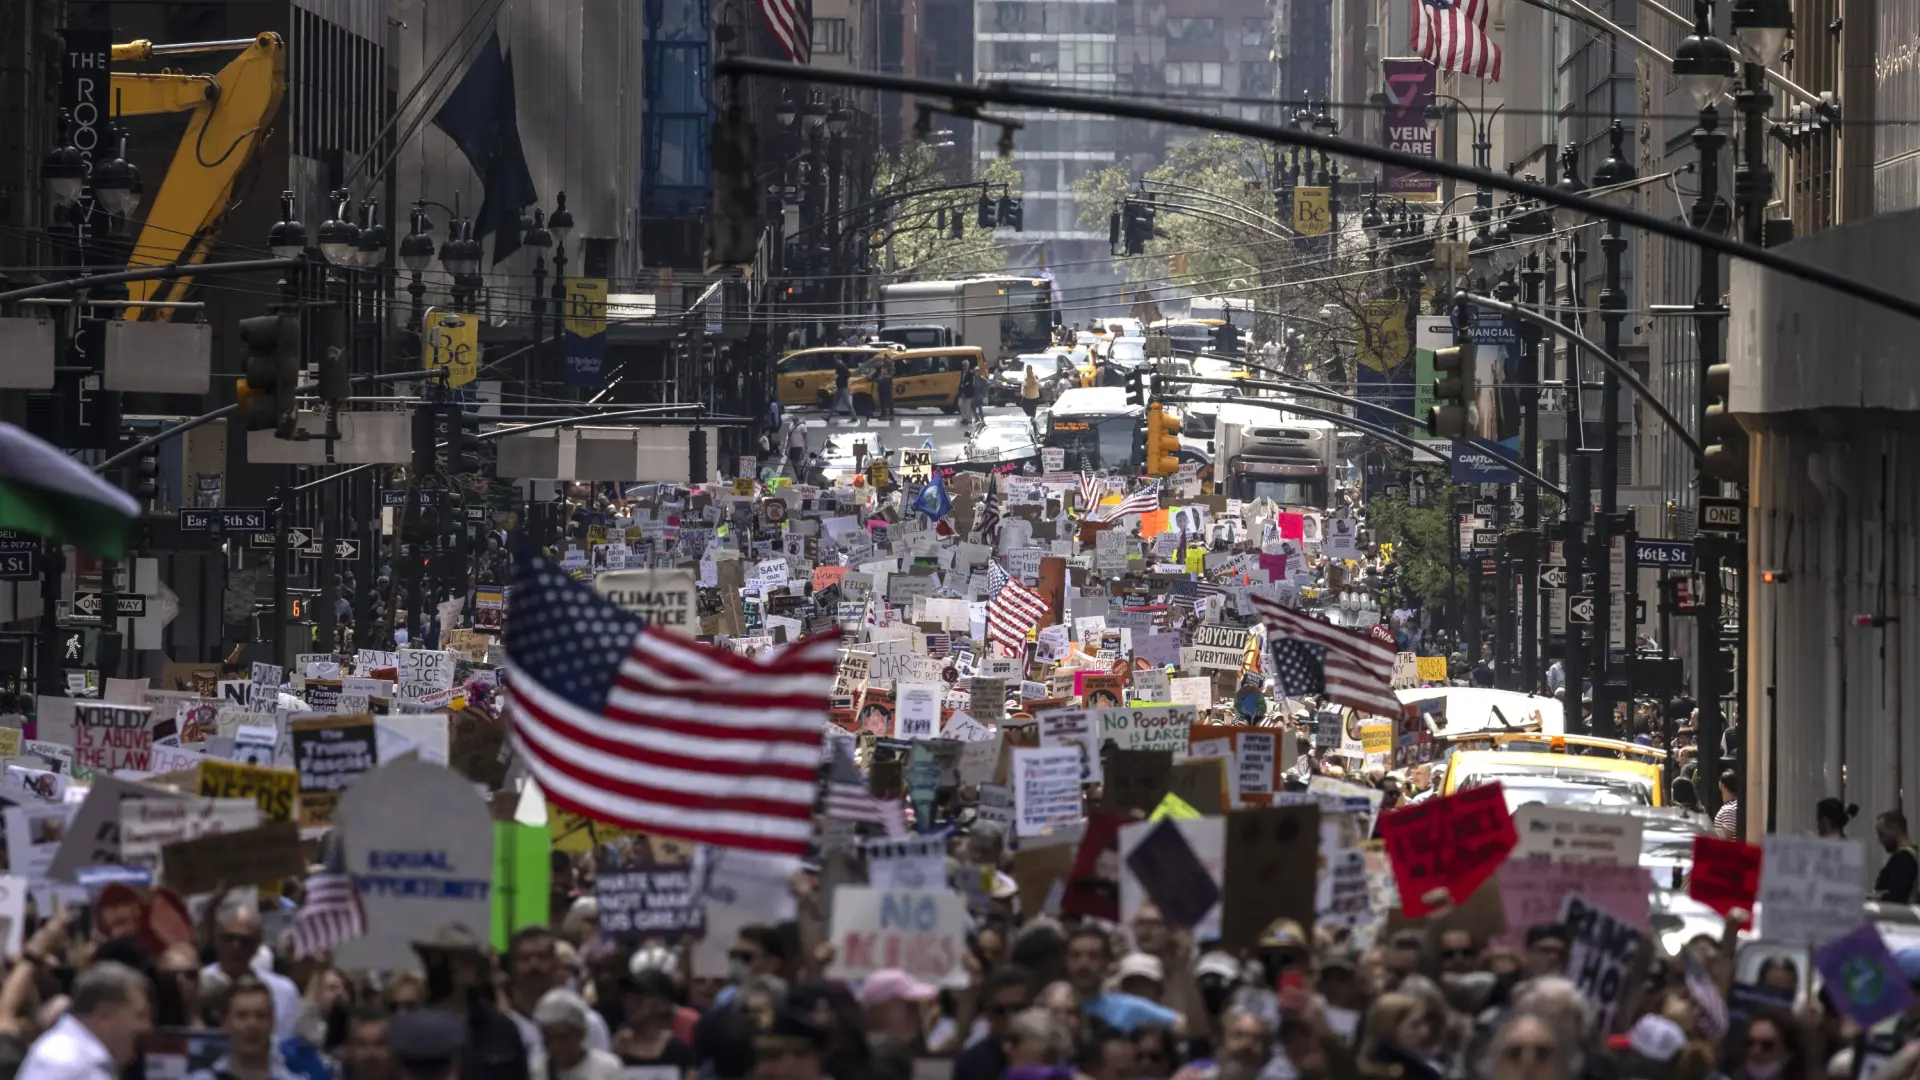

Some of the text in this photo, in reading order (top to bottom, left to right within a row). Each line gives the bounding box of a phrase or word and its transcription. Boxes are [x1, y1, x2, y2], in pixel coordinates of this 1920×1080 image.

[69, 52, 106, 70] THE
[1390, 126, 1432, 140] VEIN
[1390, 142, 1432, 155] CARE
[571, 293, 603, 316] Be
[1457, 328, 1516, 338] NANCIAL
[433, 333, 471, 365] Be
[1458, 455, 1498, 463] CANTO
[187, 514, 208, 525] Eas
[247, 514, 260, 525] St
[1709, 508, 1739, 522] ONE
[288, 535, 302, 543] AY
[1478, 534, 1497, 543] ONE
[1636, 547, 1666, 561] 46th
[1671, 548, 1687, 562] St
[8, 557, 25, 572] St
[760, 562, 786, 575] SAVE
[1213, 555, 1245, 576] DISSENT
[1549, 572, 1568, 582] ONE
[84, 600, 103, 609] ONE
[606, 590, 688, 606] CLIMATE
[645, 610, 687, 625] TICE
[1581, 605, 1594, 615] ON
[1197, 626, 1248, 649] BOYCOTT
[358, 652, 393, 667] USA IS
[408, 652, 444, 668] STOP
[1194, 650, 1243, 668] EVERYTHING
[1397, 652, 1415, 664] THE
[869, 654, 913, 679] LMAR
[415, 669, 439, 682] ICE
[309, 690, 339, 700] Trump
[941, 700, 972, 710] REJE
[75, 706, 152, 730] NOBODY
[77, 725, 152, 751] IS ABOVE
[1129, 726, 1189, 744] IS LARGE
[76, 744, 151, 772] THE LAW
[881, 892, 938, 933] NO
